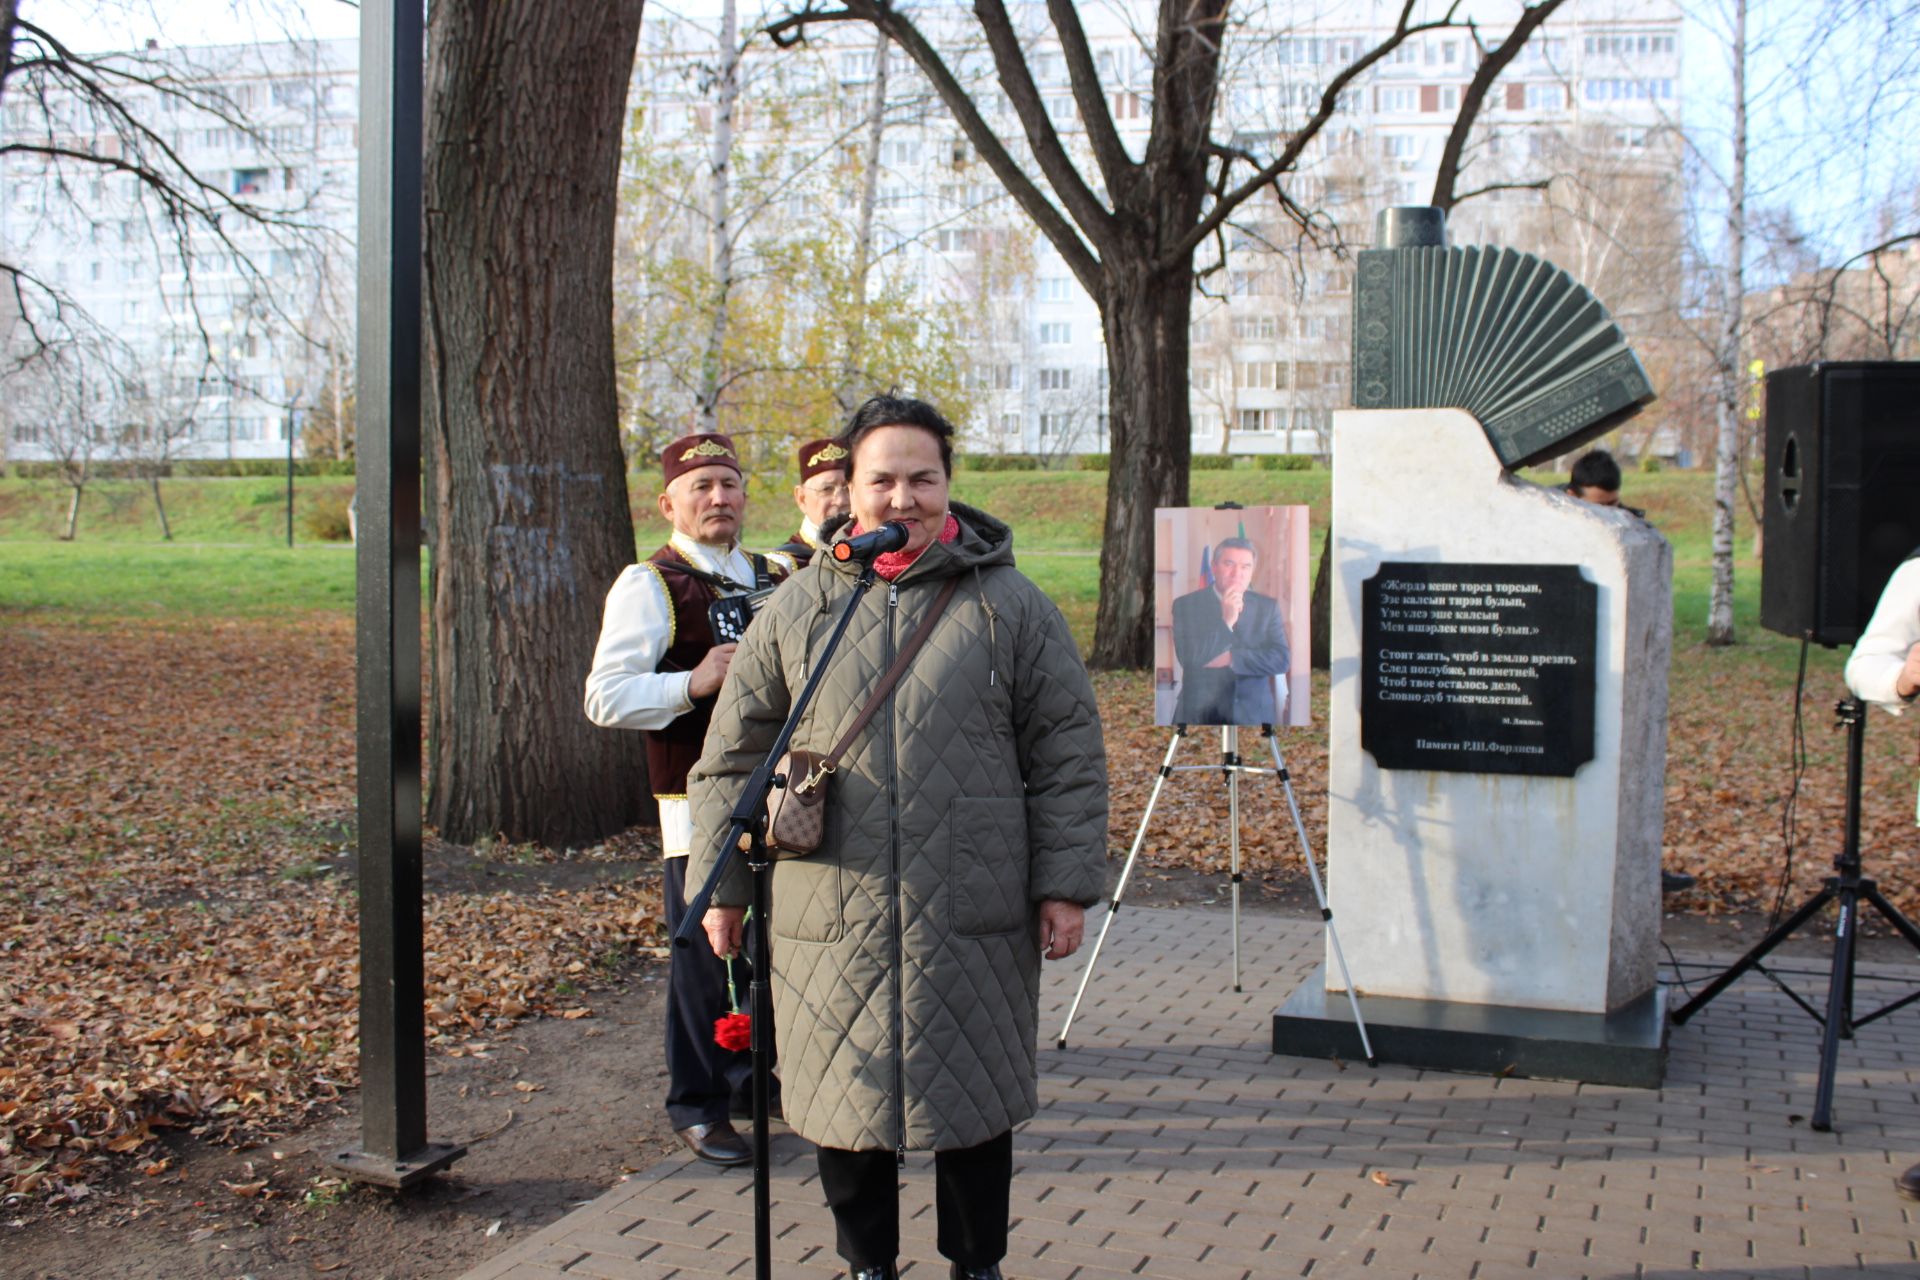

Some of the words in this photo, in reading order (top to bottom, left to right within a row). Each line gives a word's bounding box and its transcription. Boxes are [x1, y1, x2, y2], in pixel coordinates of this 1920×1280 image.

[1428, 582, 1458, 592] кеше
[1460, 583, 1493, 595] торса
[1495, 583, 1543, 596] торсын,
[1380, 594, 1400, 604] Эзе
[1403, 595, 1446, 606] калсын
[1485, 595, 1526, 609] булып,
[1455, 610, 1500, 621] калсын
[1379, 648, 1415, 660] Стоит
[1416, 651, 1450, 662] жить,
[1451, 650, 1480, 662] чтоб
[1480, 653, 1490, 663] в
[1491, 653, 1530, 664] землю
[1379, 662, 1408, 674] След
[1409, 664, 1467, 678] поглубже,
[1468, 666, 1540, 680] позаметней,
[1379, 676, 1408, 688] Чтоб
[1410, 678, 1435, 688] твое
[1437, 680, 1489, 691] осталось
[1490, 681, 1522, 694] дело,
[1379, 690, 1422, 701] Словно
[1423, 691, 1444, 705] дуб
[1445, 693, 1533, 706] тысячелетний.
[1416, 738, 1460, 751] Памяти
